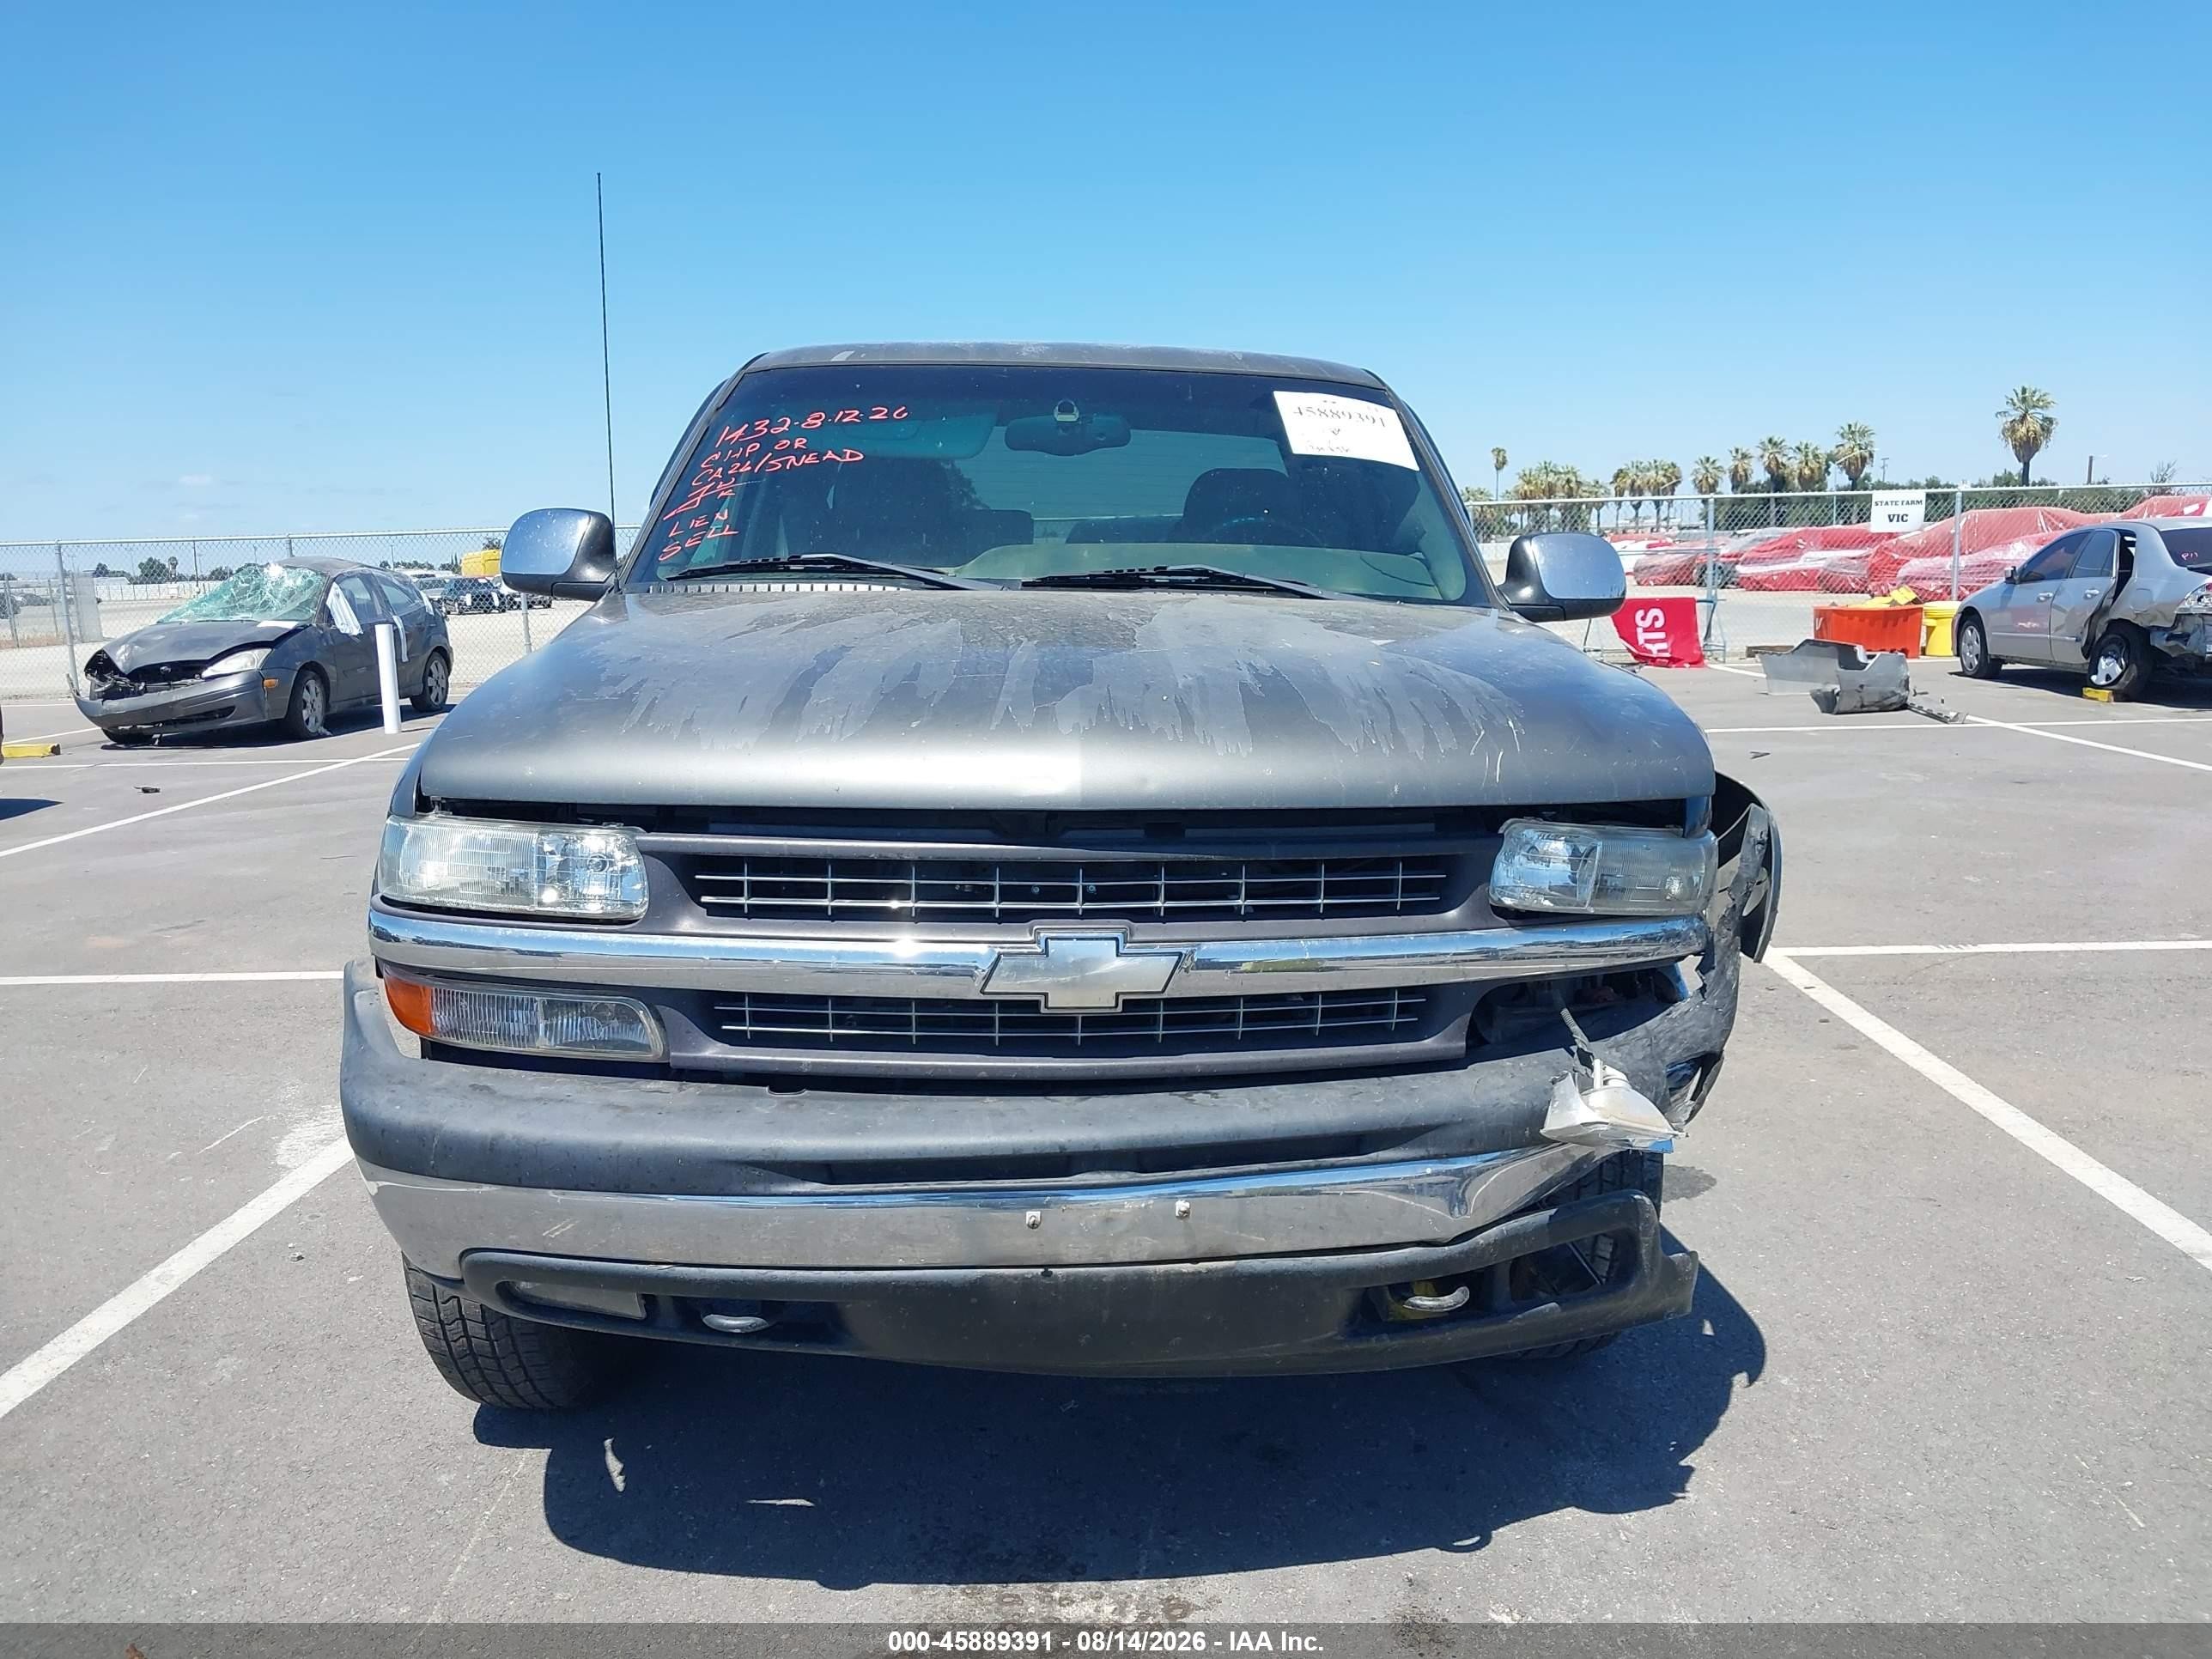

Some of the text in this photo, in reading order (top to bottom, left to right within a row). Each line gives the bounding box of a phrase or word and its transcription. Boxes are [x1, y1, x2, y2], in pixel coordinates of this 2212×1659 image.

[775, 437, 807, 452] OR
[668, 508, 728, 538] LIEN
[1887, 514, 1909, 523] VIC
[658, 525, 739, 561] SELL
